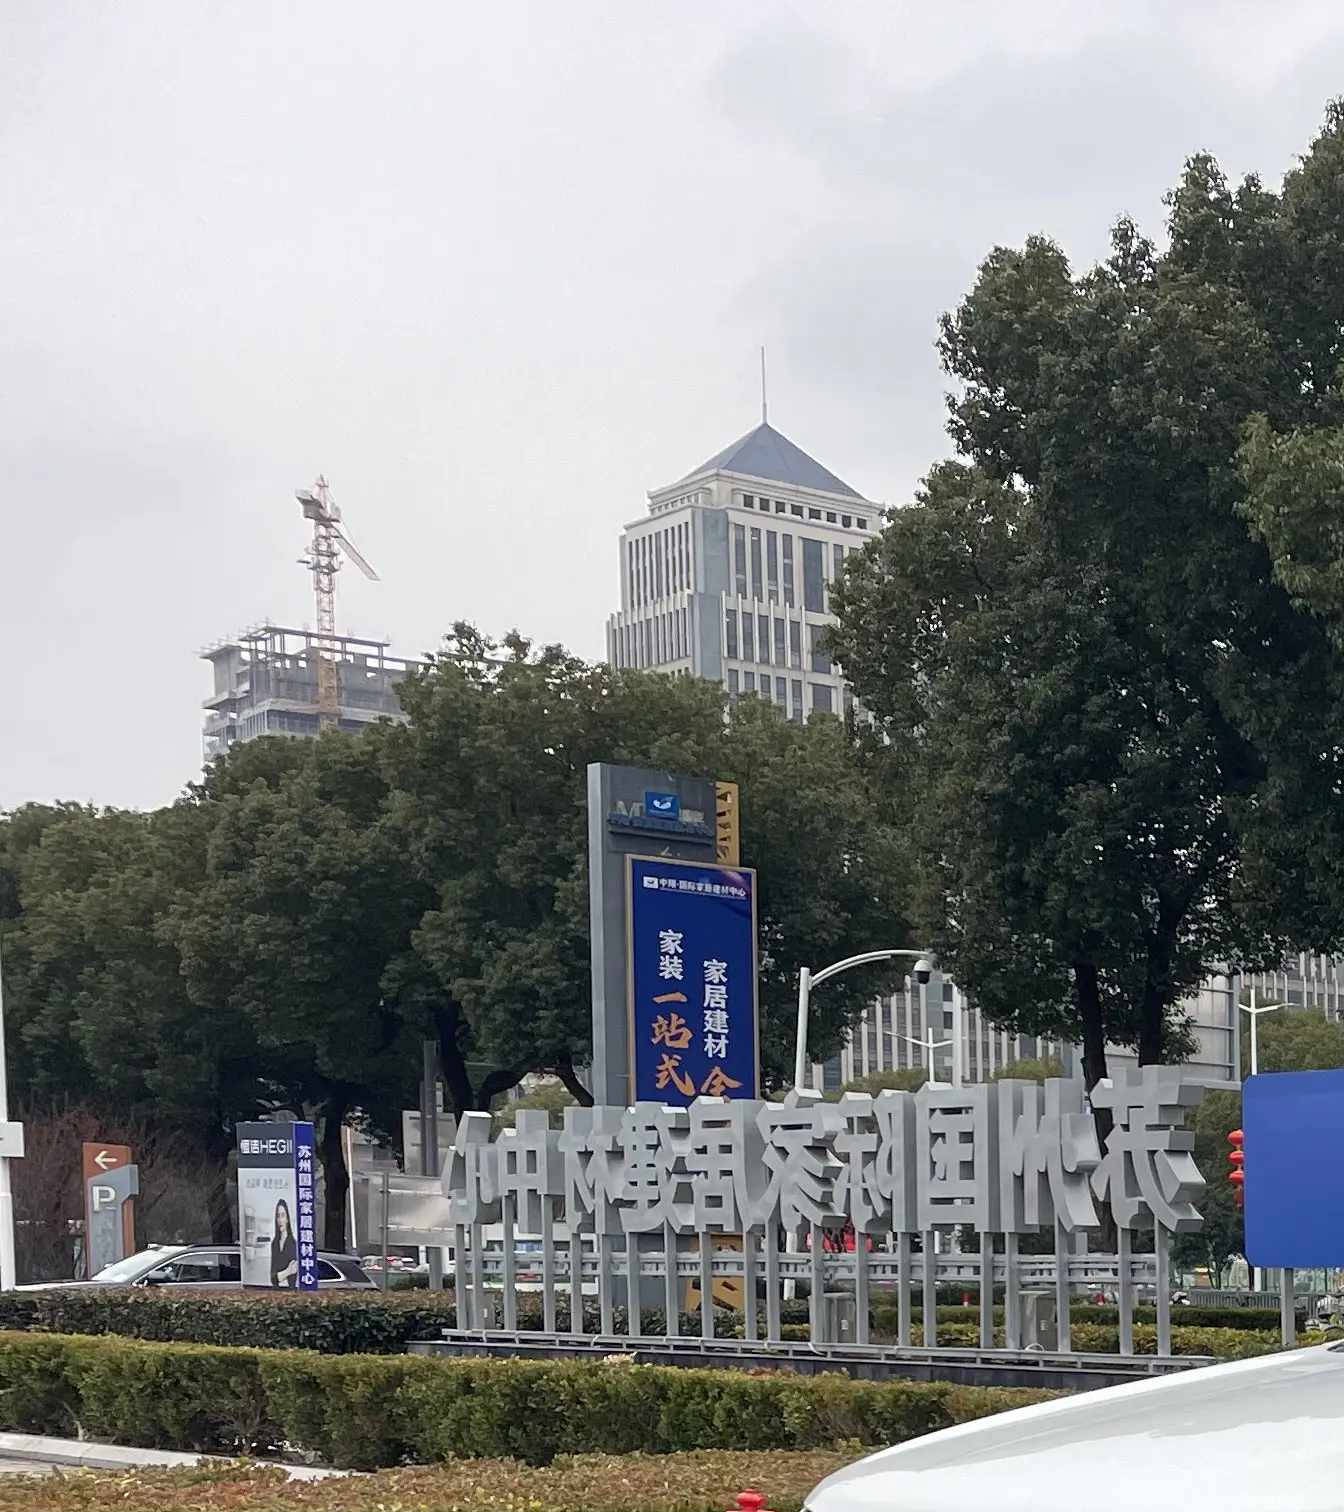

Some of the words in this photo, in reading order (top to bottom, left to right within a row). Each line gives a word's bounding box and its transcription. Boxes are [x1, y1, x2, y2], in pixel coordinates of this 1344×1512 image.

[651, 929, 696, 1097] 家装一站式
[92, 1185, 116, 1212] P
[297, 1144, 315, 1285] 苏州国际家居建材中心
